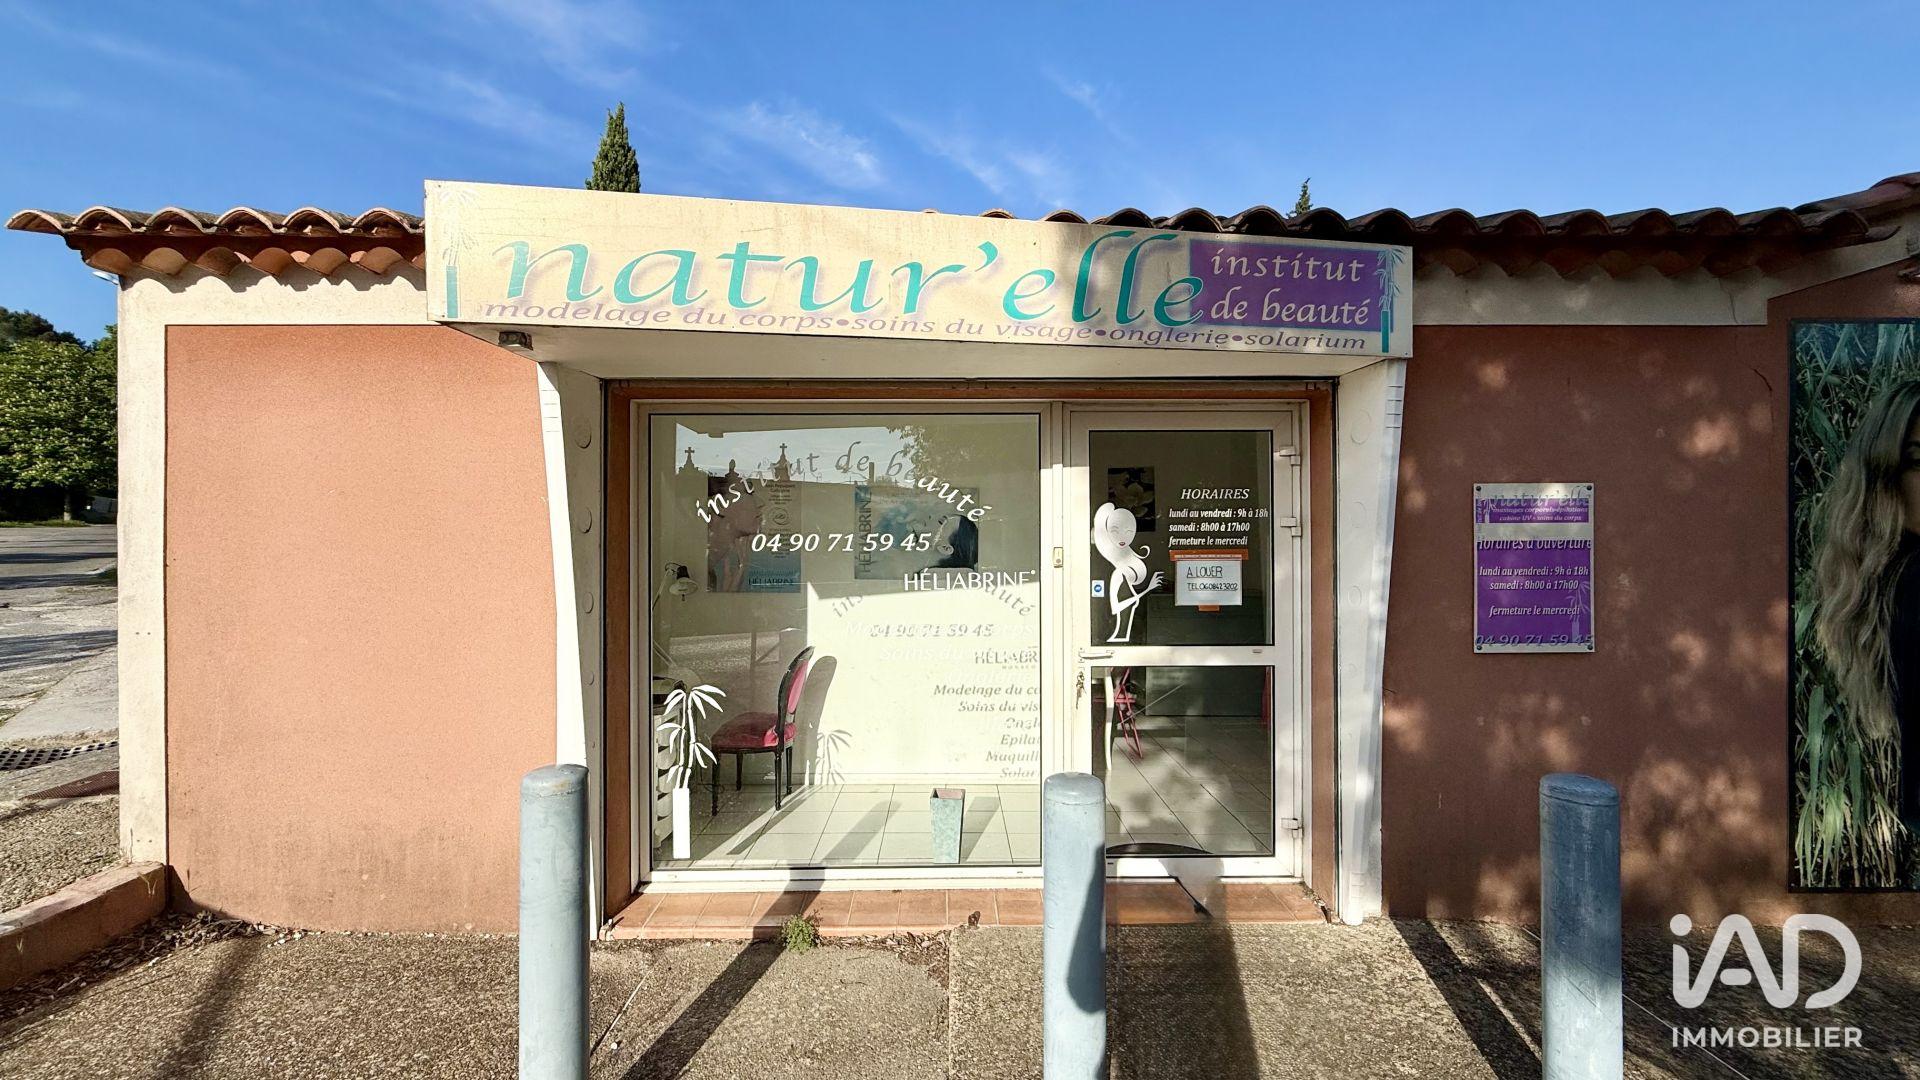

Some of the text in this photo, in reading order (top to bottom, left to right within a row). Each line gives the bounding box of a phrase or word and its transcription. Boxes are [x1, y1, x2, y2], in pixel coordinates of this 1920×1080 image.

[1211, 249, 1365, 283] institut
[491, 229, 1205, 328] natur'elle
[1210, 287, 1370, 326] de beauté
[484, 302, 671, 327] modelage
[683, 306, 727, 326] du
[945, 316, 984, 335] du
[834, 440, 870, 473] de
[1180, 488, 1250, 500] HORAIRES
[1169, 508, 1189, 518] lundi
[1189, 509, 1199, 518] au
[1200, 508, 1232, 518] vendredi
[1237, 508, 1247, 518] 9h
[1248, 508, 1253, 518] à
[1254, 508, 1269, 518] 18h
[1169, 522, 1196, 532] samedi
[1200, 522, 1220, 532] 8h00
[1220, 523, 1226, 532] à
[1226, 522, 1250, 532] 17h00
[751, 532, 781, 552] 04
[789, 532, 820, 552] 90
[828, 532, 855, 552] 71
[863, 532, 894, 552] 59
[900, 532, 932, 552] 45
[1168, 536, 1248, 547] fermeture le mercredi
[1187, 565, 1222, 578] A LOUER
[1480, 566, 1501, 576] lundi
[1502, 568, 1513, 576] au
[1514, 566, 1549, 577] vendredi
[1554, 566, 1565, 576] 9h
[1566, 566, 1572, 576] à
[1574, 566, 1589, 576] 18h
[1490, 580, 1519, 590] samedi
[1524, 580, 1545, 590] 8h00
[1546, 580, 1551, 590] à
[1554, 580, 1579, 590] 17h00
[1489, 605, 1580, 617] fermeture le mercredi
[1476, 634, 1593, 646] 04 90 71 59 45
